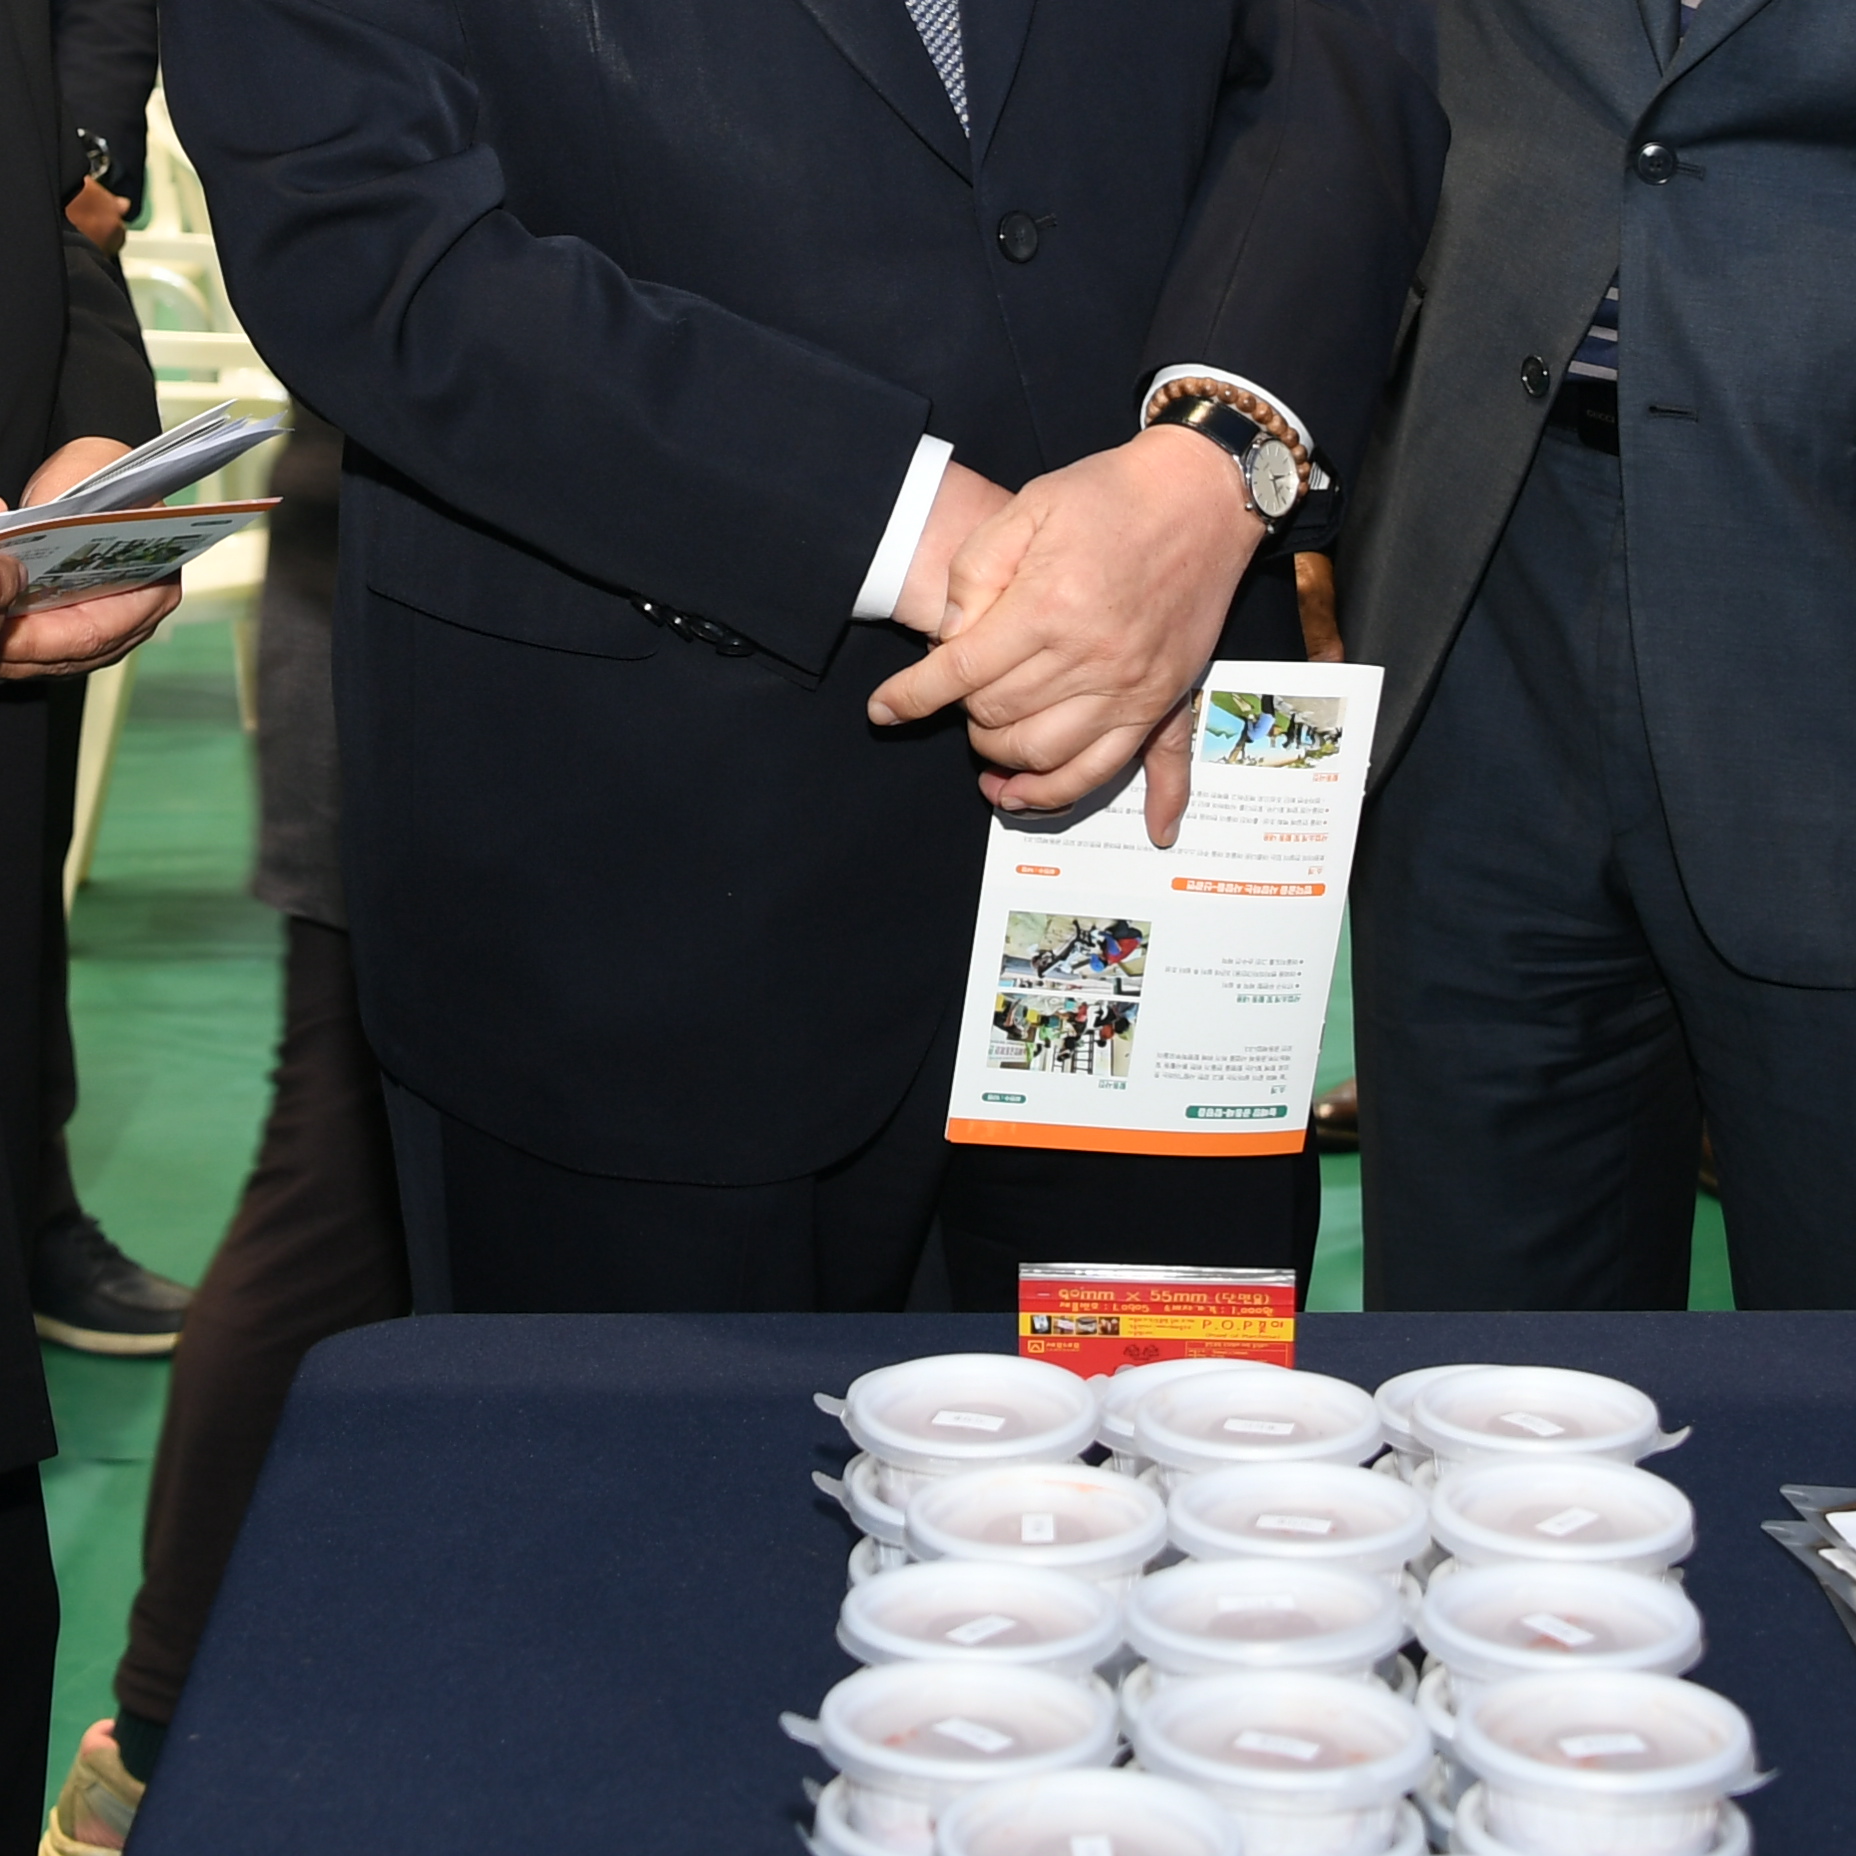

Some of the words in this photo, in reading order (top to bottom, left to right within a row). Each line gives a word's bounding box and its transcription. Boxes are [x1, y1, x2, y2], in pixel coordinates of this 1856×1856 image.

[1243, 883, 1279, 895] 사랑하는
[1057, 1288, 1115, 1301] 90mm
[1150, 1290, 1208, 1303] 55mm
[1214, 1293, 1270, 1305] (단면용)
[1231, 1306, 1274, 1317] 1,000원
